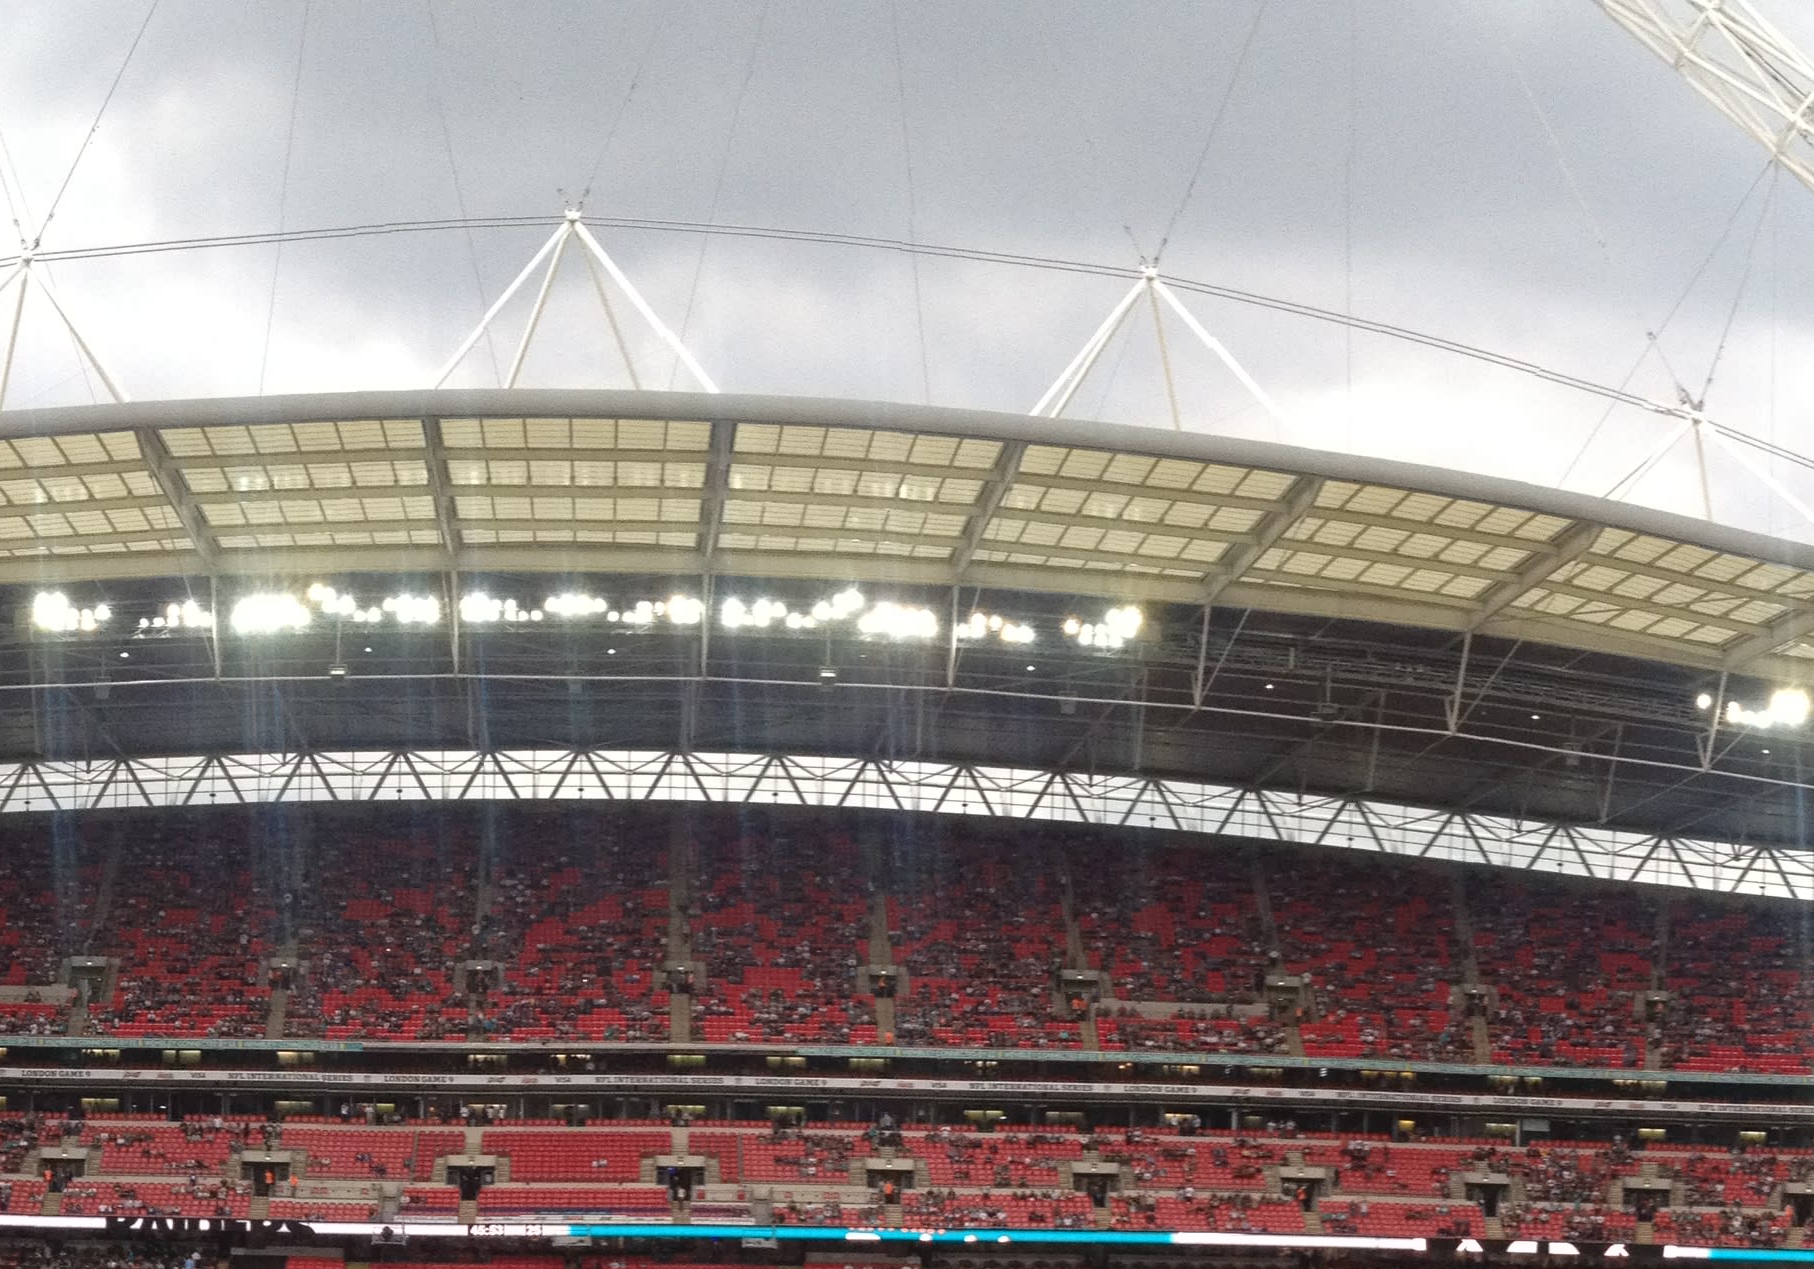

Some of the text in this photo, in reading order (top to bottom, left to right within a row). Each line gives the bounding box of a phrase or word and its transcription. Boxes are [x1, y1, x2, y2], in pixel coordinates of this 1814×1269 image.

[22, 1069, 54, 1078] LONDON
[55, 1069, 84, 1078] GAME
[228, 1073, 246, 1081] NFL
[322, 1074, 353, 1082] SERIES
[384, 1075, 419, 1083] LONDON
[421, 1075, 446, 1083] GAME
[525, 1224, 542, 1236] 25
